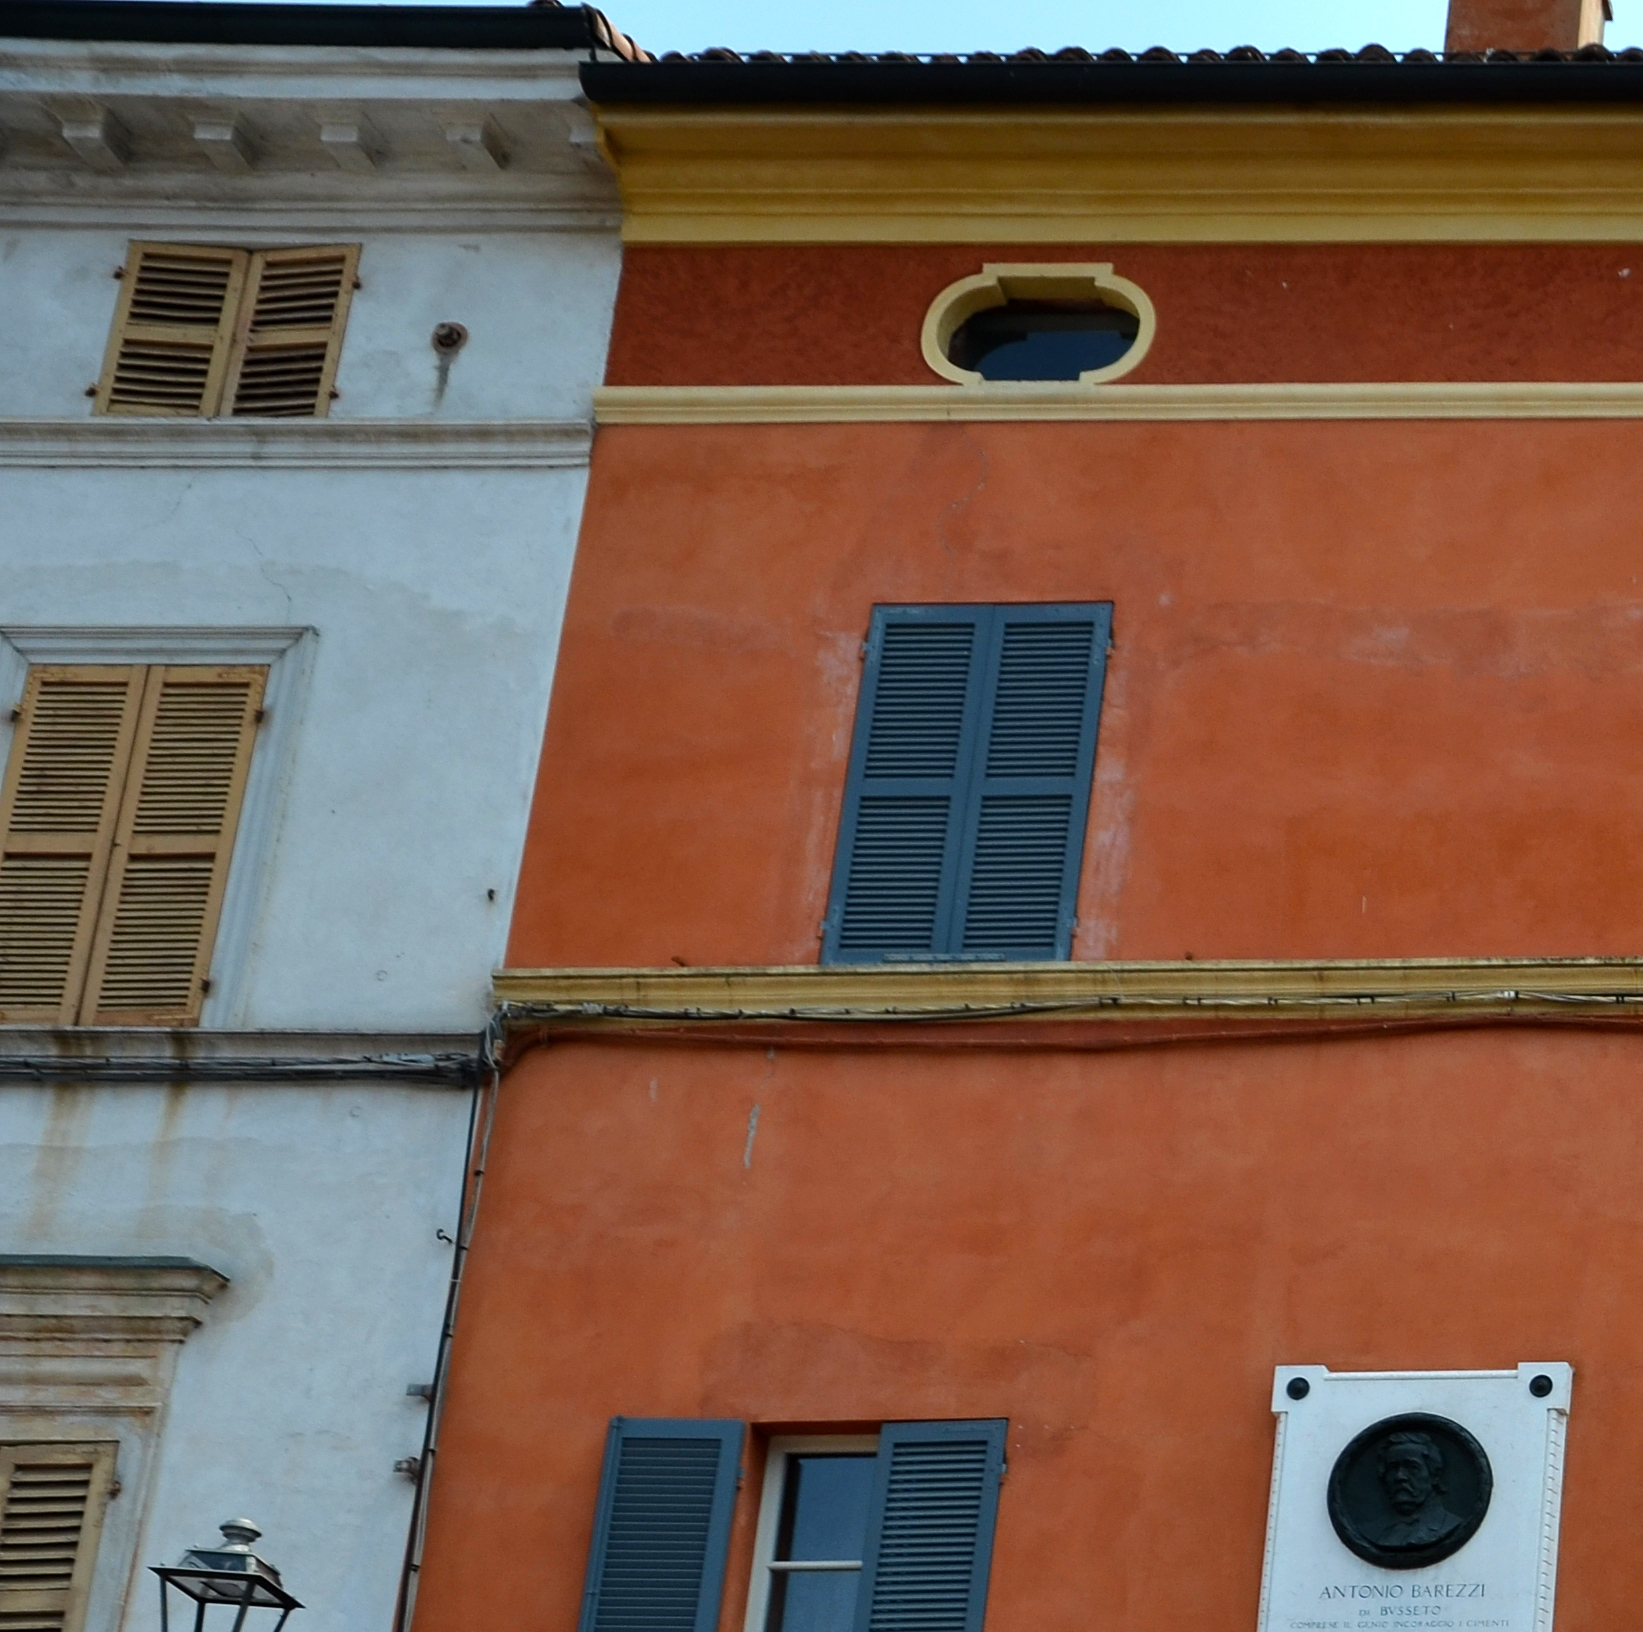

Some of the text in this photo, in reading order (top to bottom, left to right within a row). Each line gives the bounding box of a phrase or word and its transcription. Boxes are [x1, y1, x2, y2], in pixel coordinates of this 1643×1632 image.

[1318, 1583, 1485, 1600] ANTONIO BAREZZI
[1380, 1605, 1441, 1616] BVSSETO
[1466, 1619, 1509, 1627] CIMENTI
